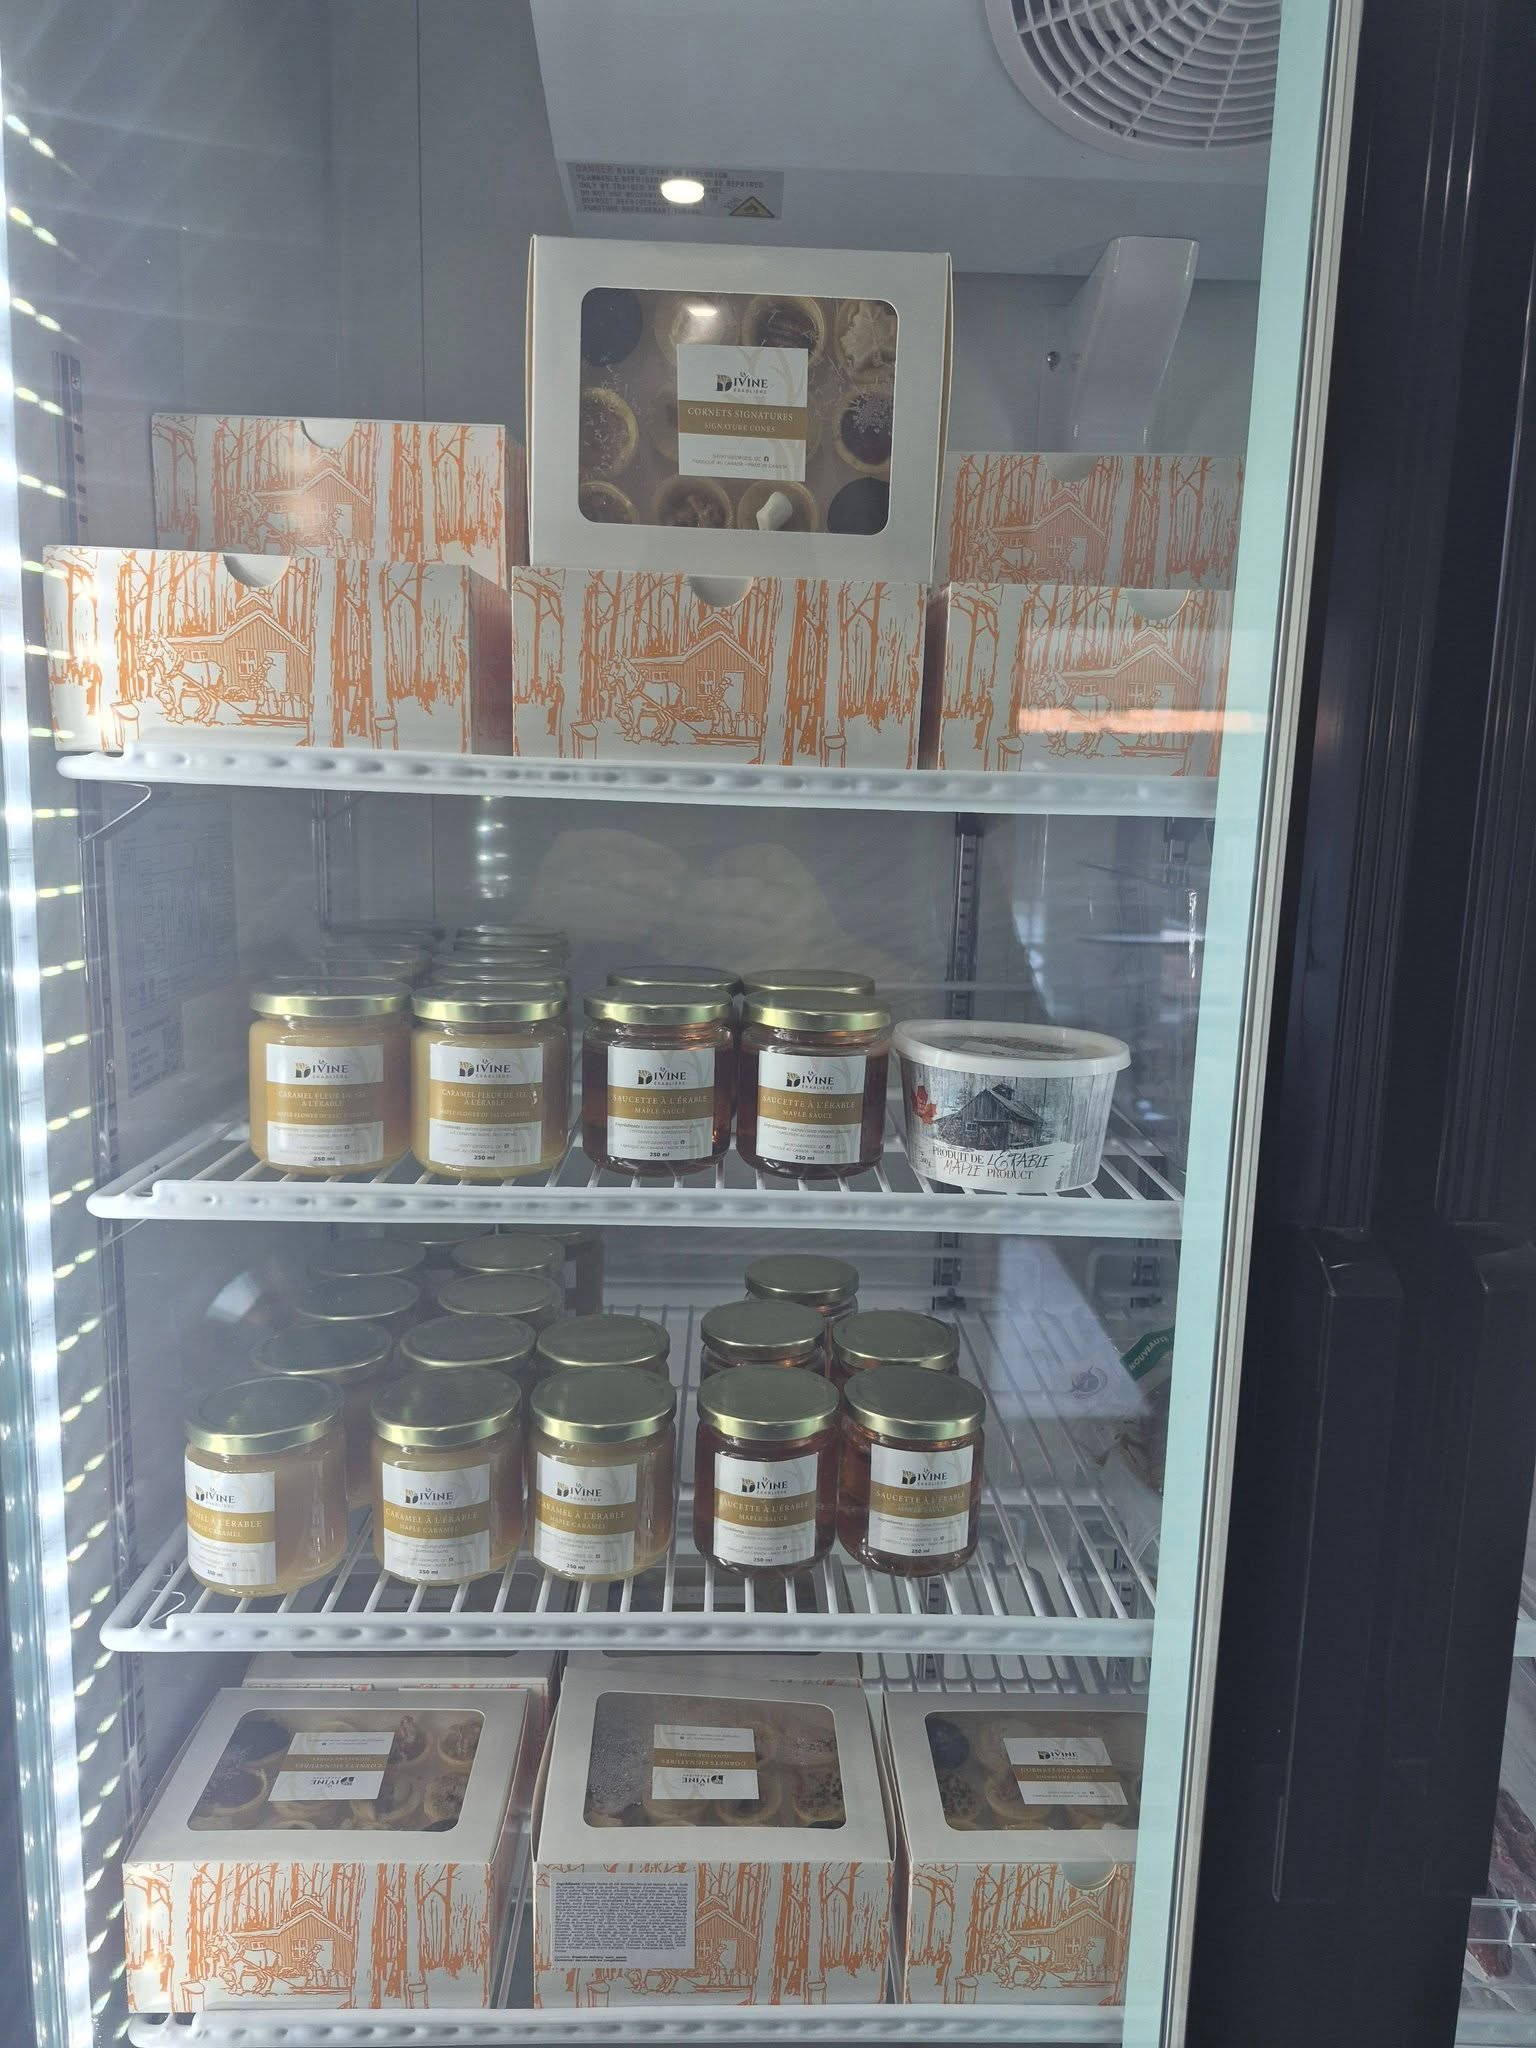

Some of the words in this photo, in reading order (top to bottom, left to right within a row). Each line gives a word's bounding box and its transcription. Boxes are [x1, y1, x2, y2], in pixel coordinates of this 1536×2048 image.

[688, 408, 732, 418] CORNETS
[734, 410, 794, 421] SIGNATURES
[704, 422, 748, 432] SIGNATURE
[441, 1088, 475, 1098] CARAMEL
[613, 1094, 658, 1104] SAUCETTE
[762, 1096, 804, 1108] SAUCETTE
[782, 1110, 806, 1118] MAPLE
[932, 1146, 968, 1162] PRODUIT
[970, 1154, 984, 1164] DE
[944, 1160, 980, 1176] MAPLE
[987, 1168, 1034, 1180] PRODUCT
[902, 1470, 948, 1485] DIVINE
[742, 1478, 788, 1492] DIVINE
[876, 1490, 920, 1503] SAUCETTE
[720, 1498, 760, 1512] SAUCETTE
[386, 1508, 424, 1524] CARAMEL
